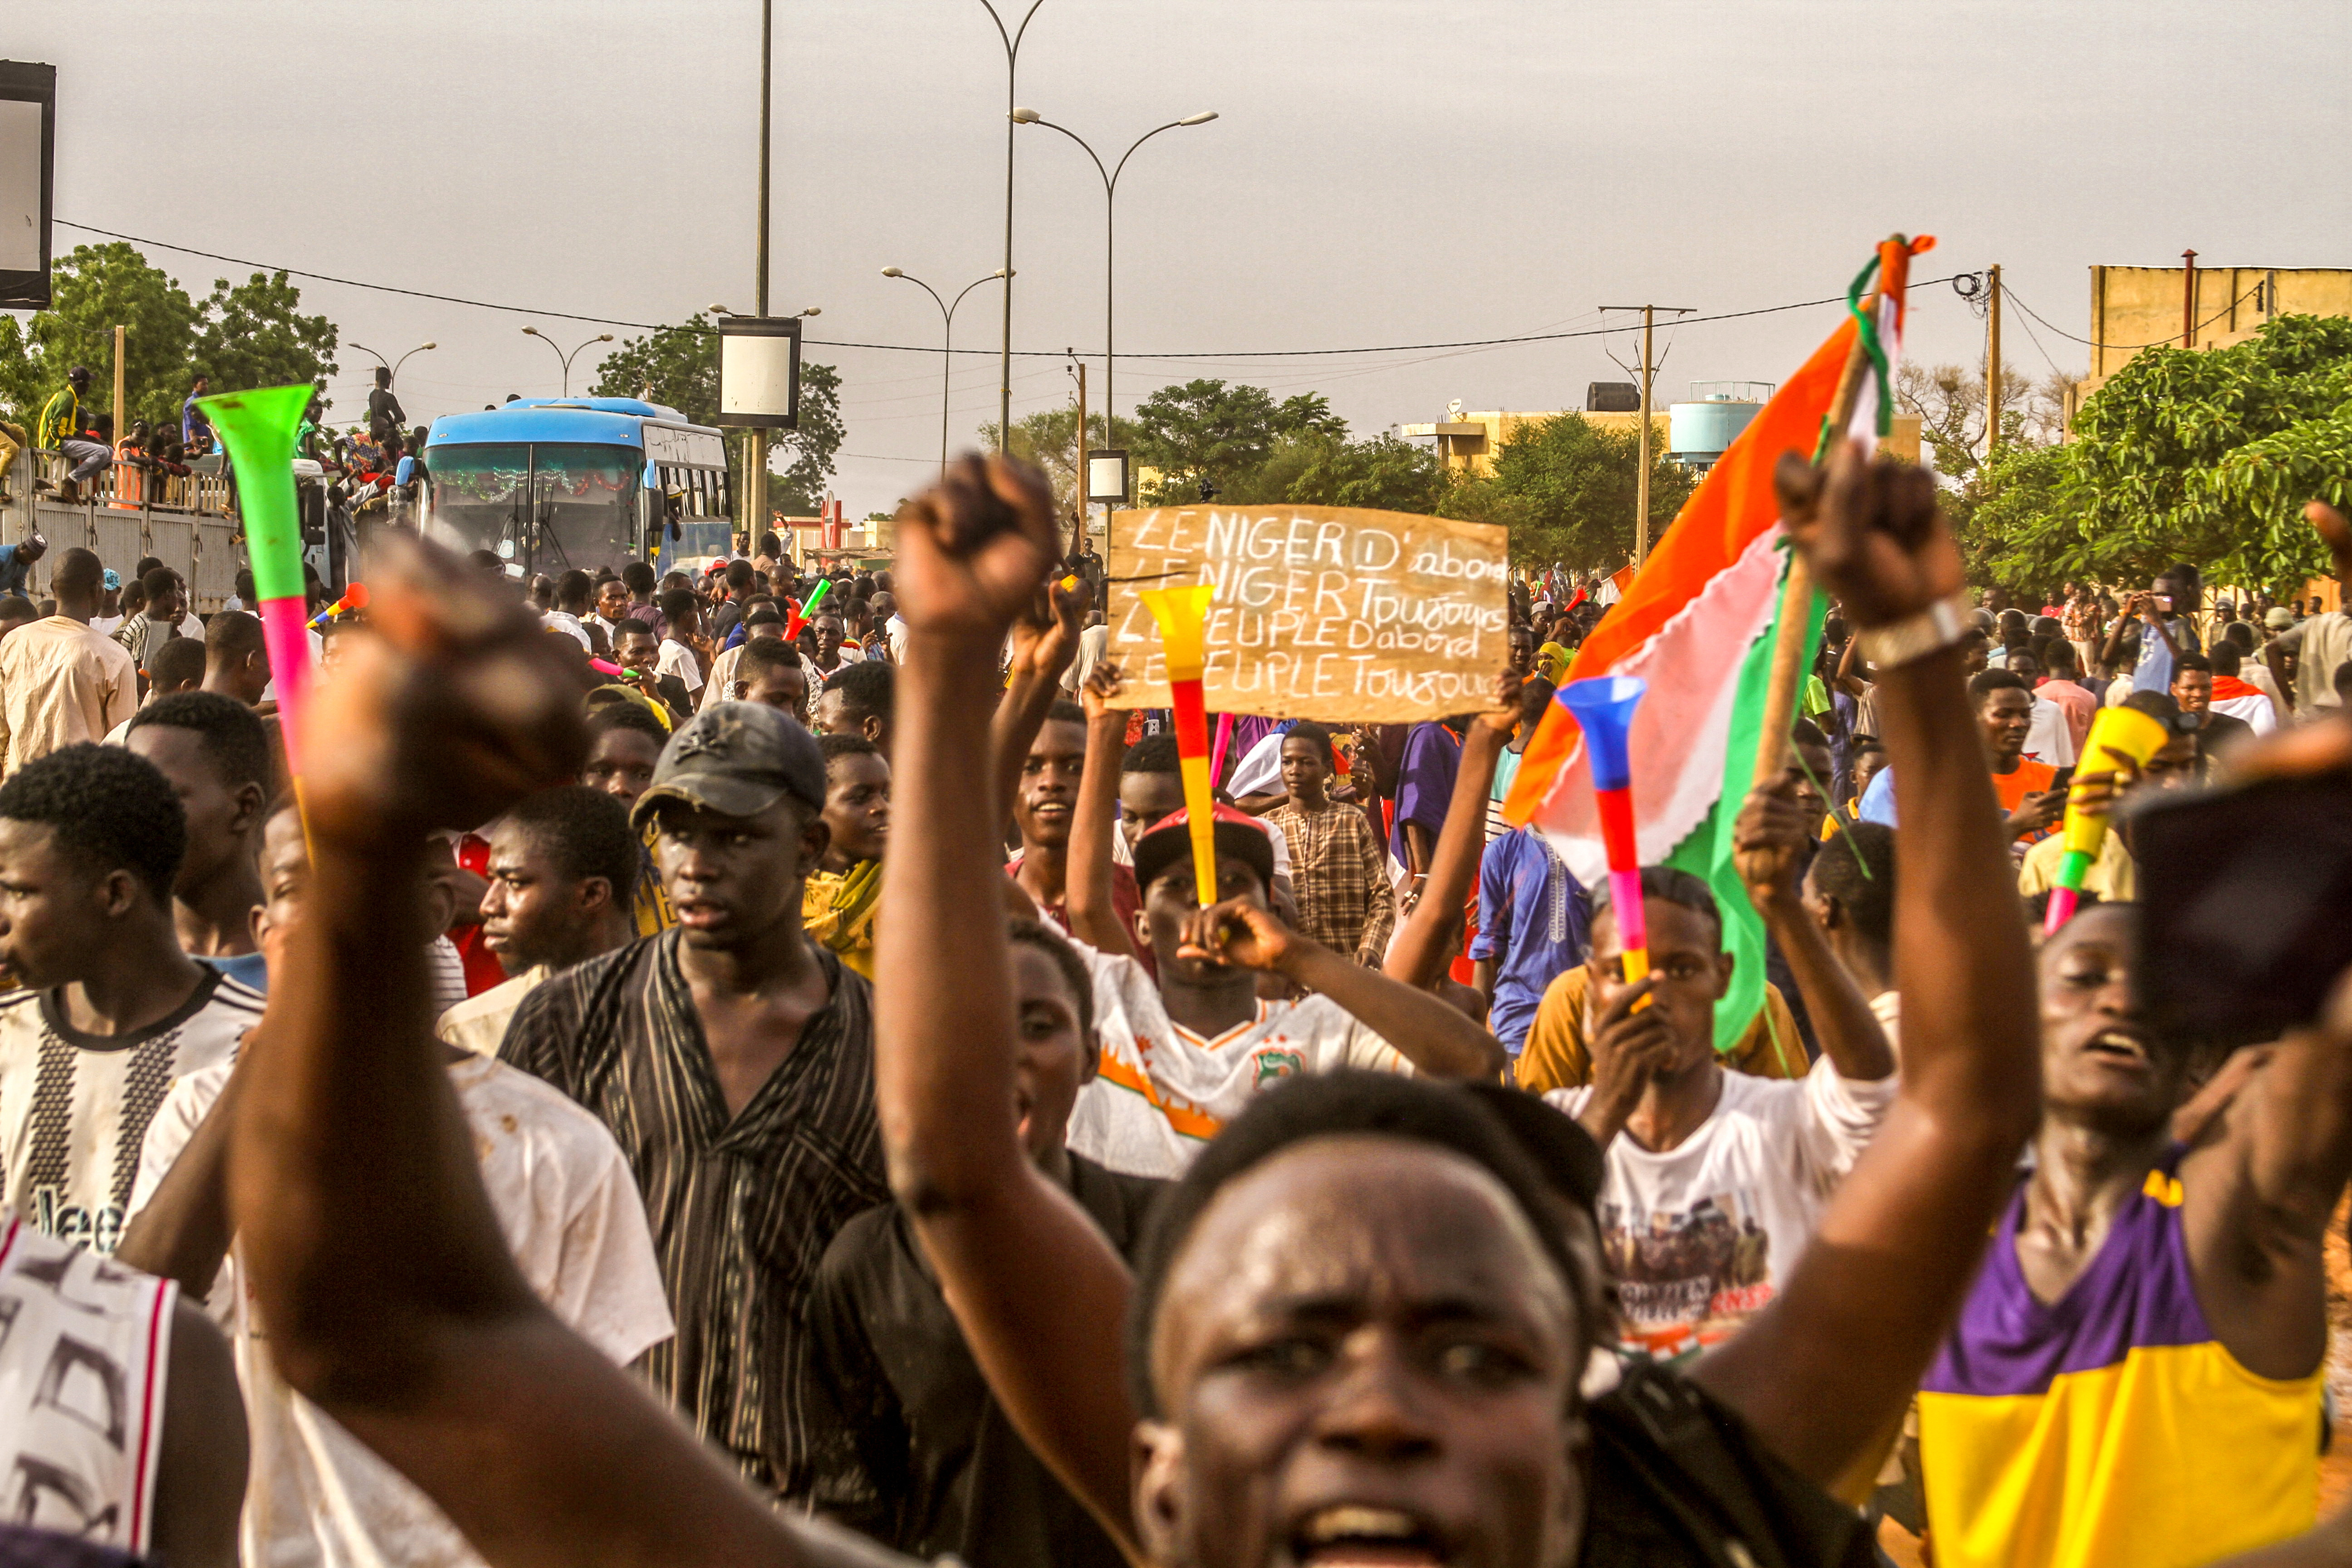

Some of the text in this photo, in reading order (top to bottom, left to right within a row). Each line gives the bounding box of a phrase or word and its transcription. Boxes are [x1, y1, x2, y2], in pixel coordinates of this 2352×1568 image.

[1132, 509, 1196, 553] LE
[1205, 511, 1345, 566] NIGER
[1197, 559, 1351, 618] NIGER
[1202, 606, 1338, 648] EUPLE
[1200, 649, 1341, 698] EUPLE
